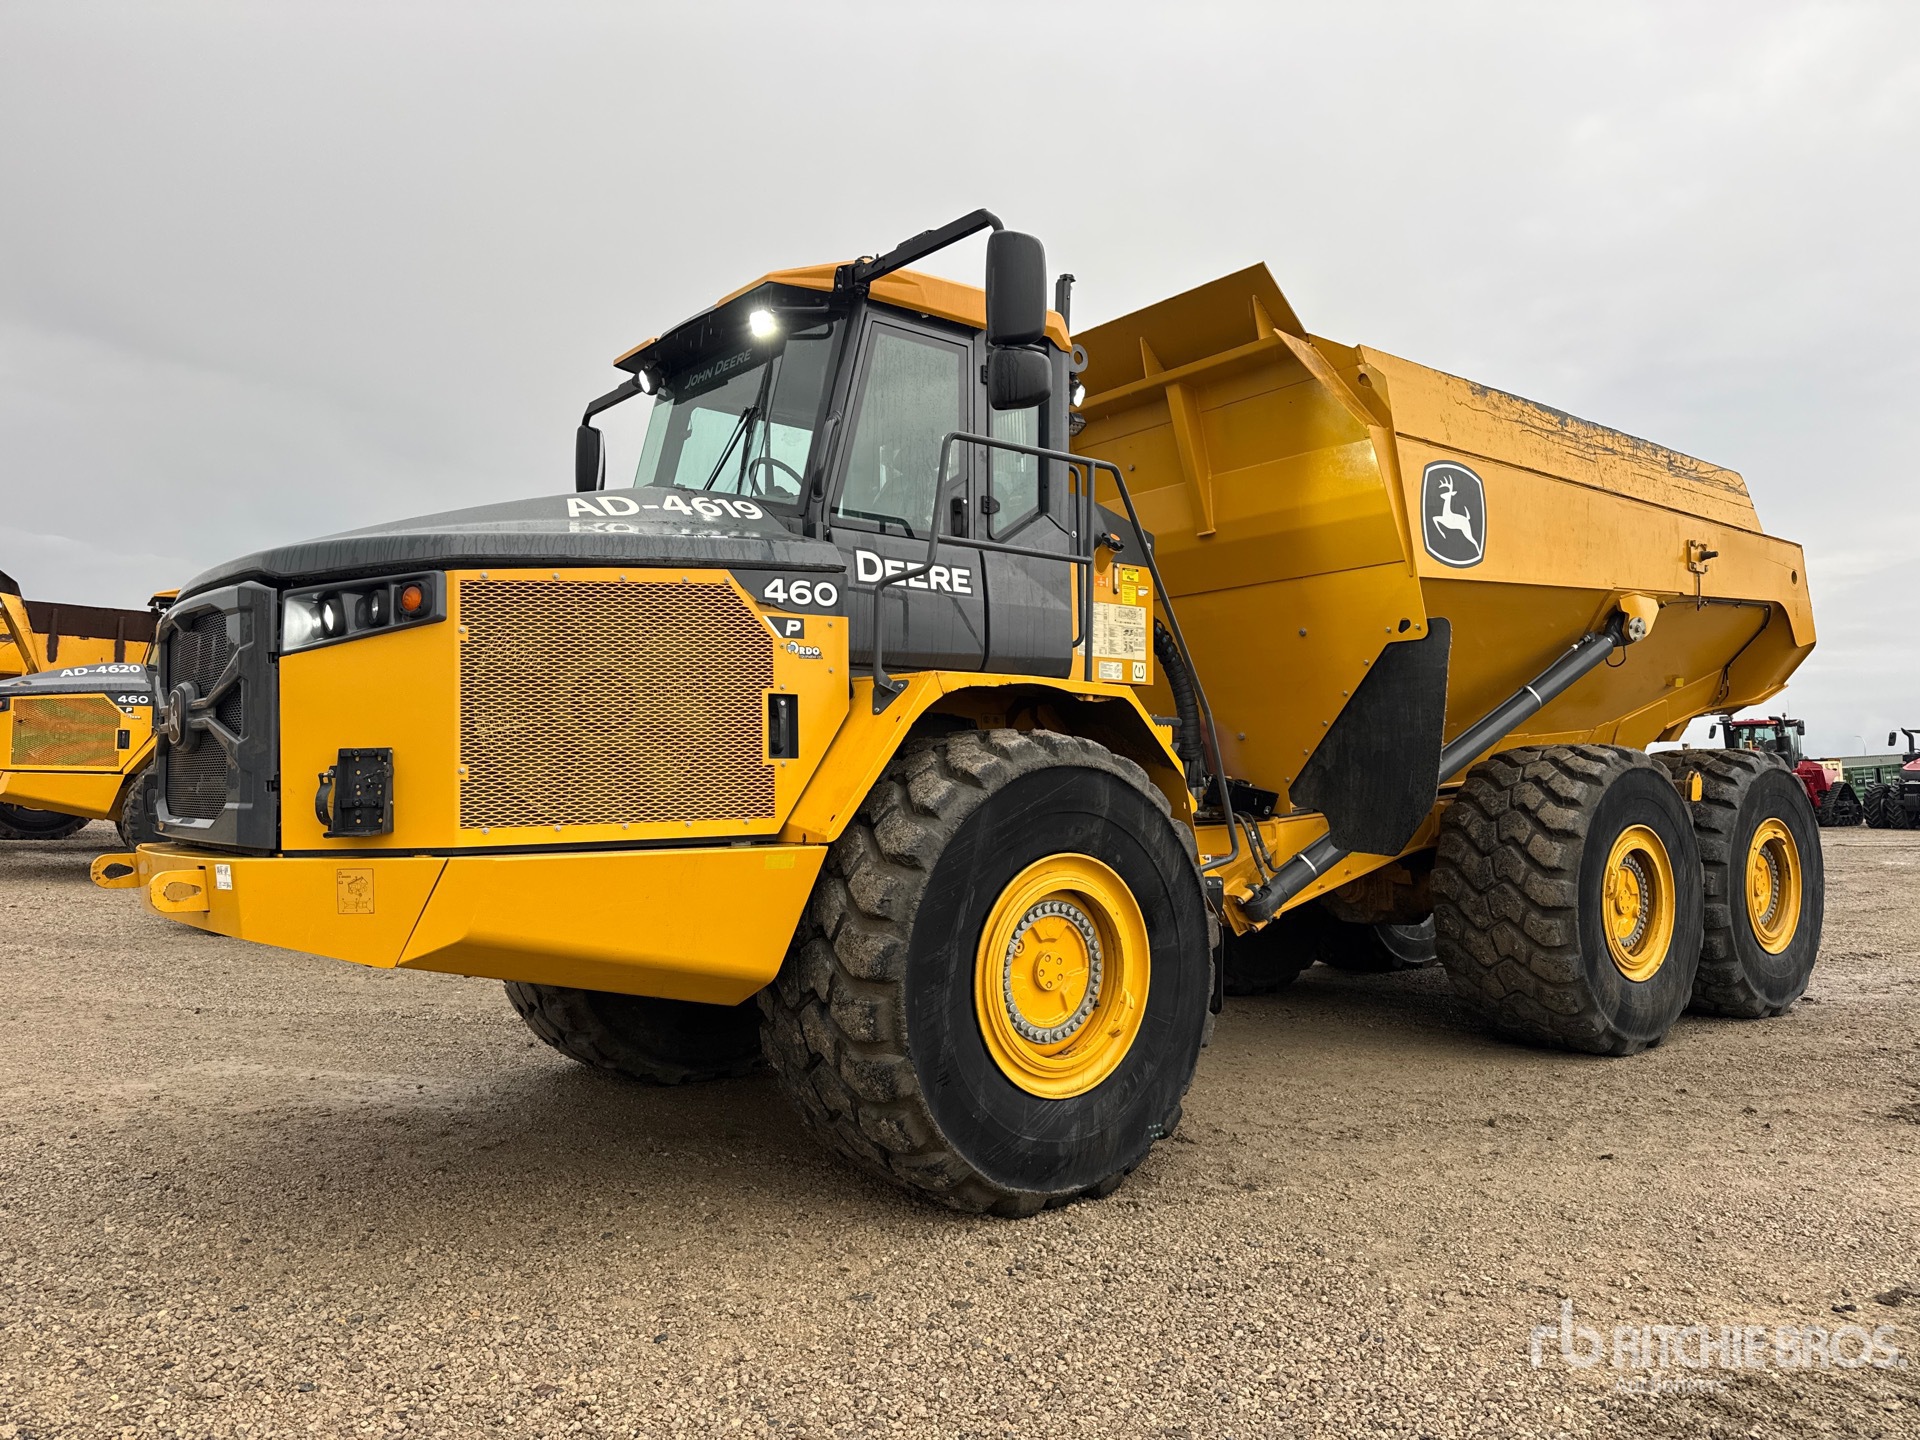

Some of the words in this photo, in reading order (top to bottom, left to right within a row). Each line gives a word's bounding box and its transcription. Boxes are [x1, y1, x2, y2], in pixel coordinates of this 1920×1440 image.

[684, 366, 714, 390] JOHN
[714, 347, 752, 376] DEERE
[566, 495, 763, 520] AD-4619
[856, 549, 972, 594] DEERE
[764, 578, 838, 607] 460
[785, 619, 802, 636] P
[799, 646, 820, 656] RDO
[60, 665, 141, 678] AD-4620
[117, 694, 149, 704] 460
